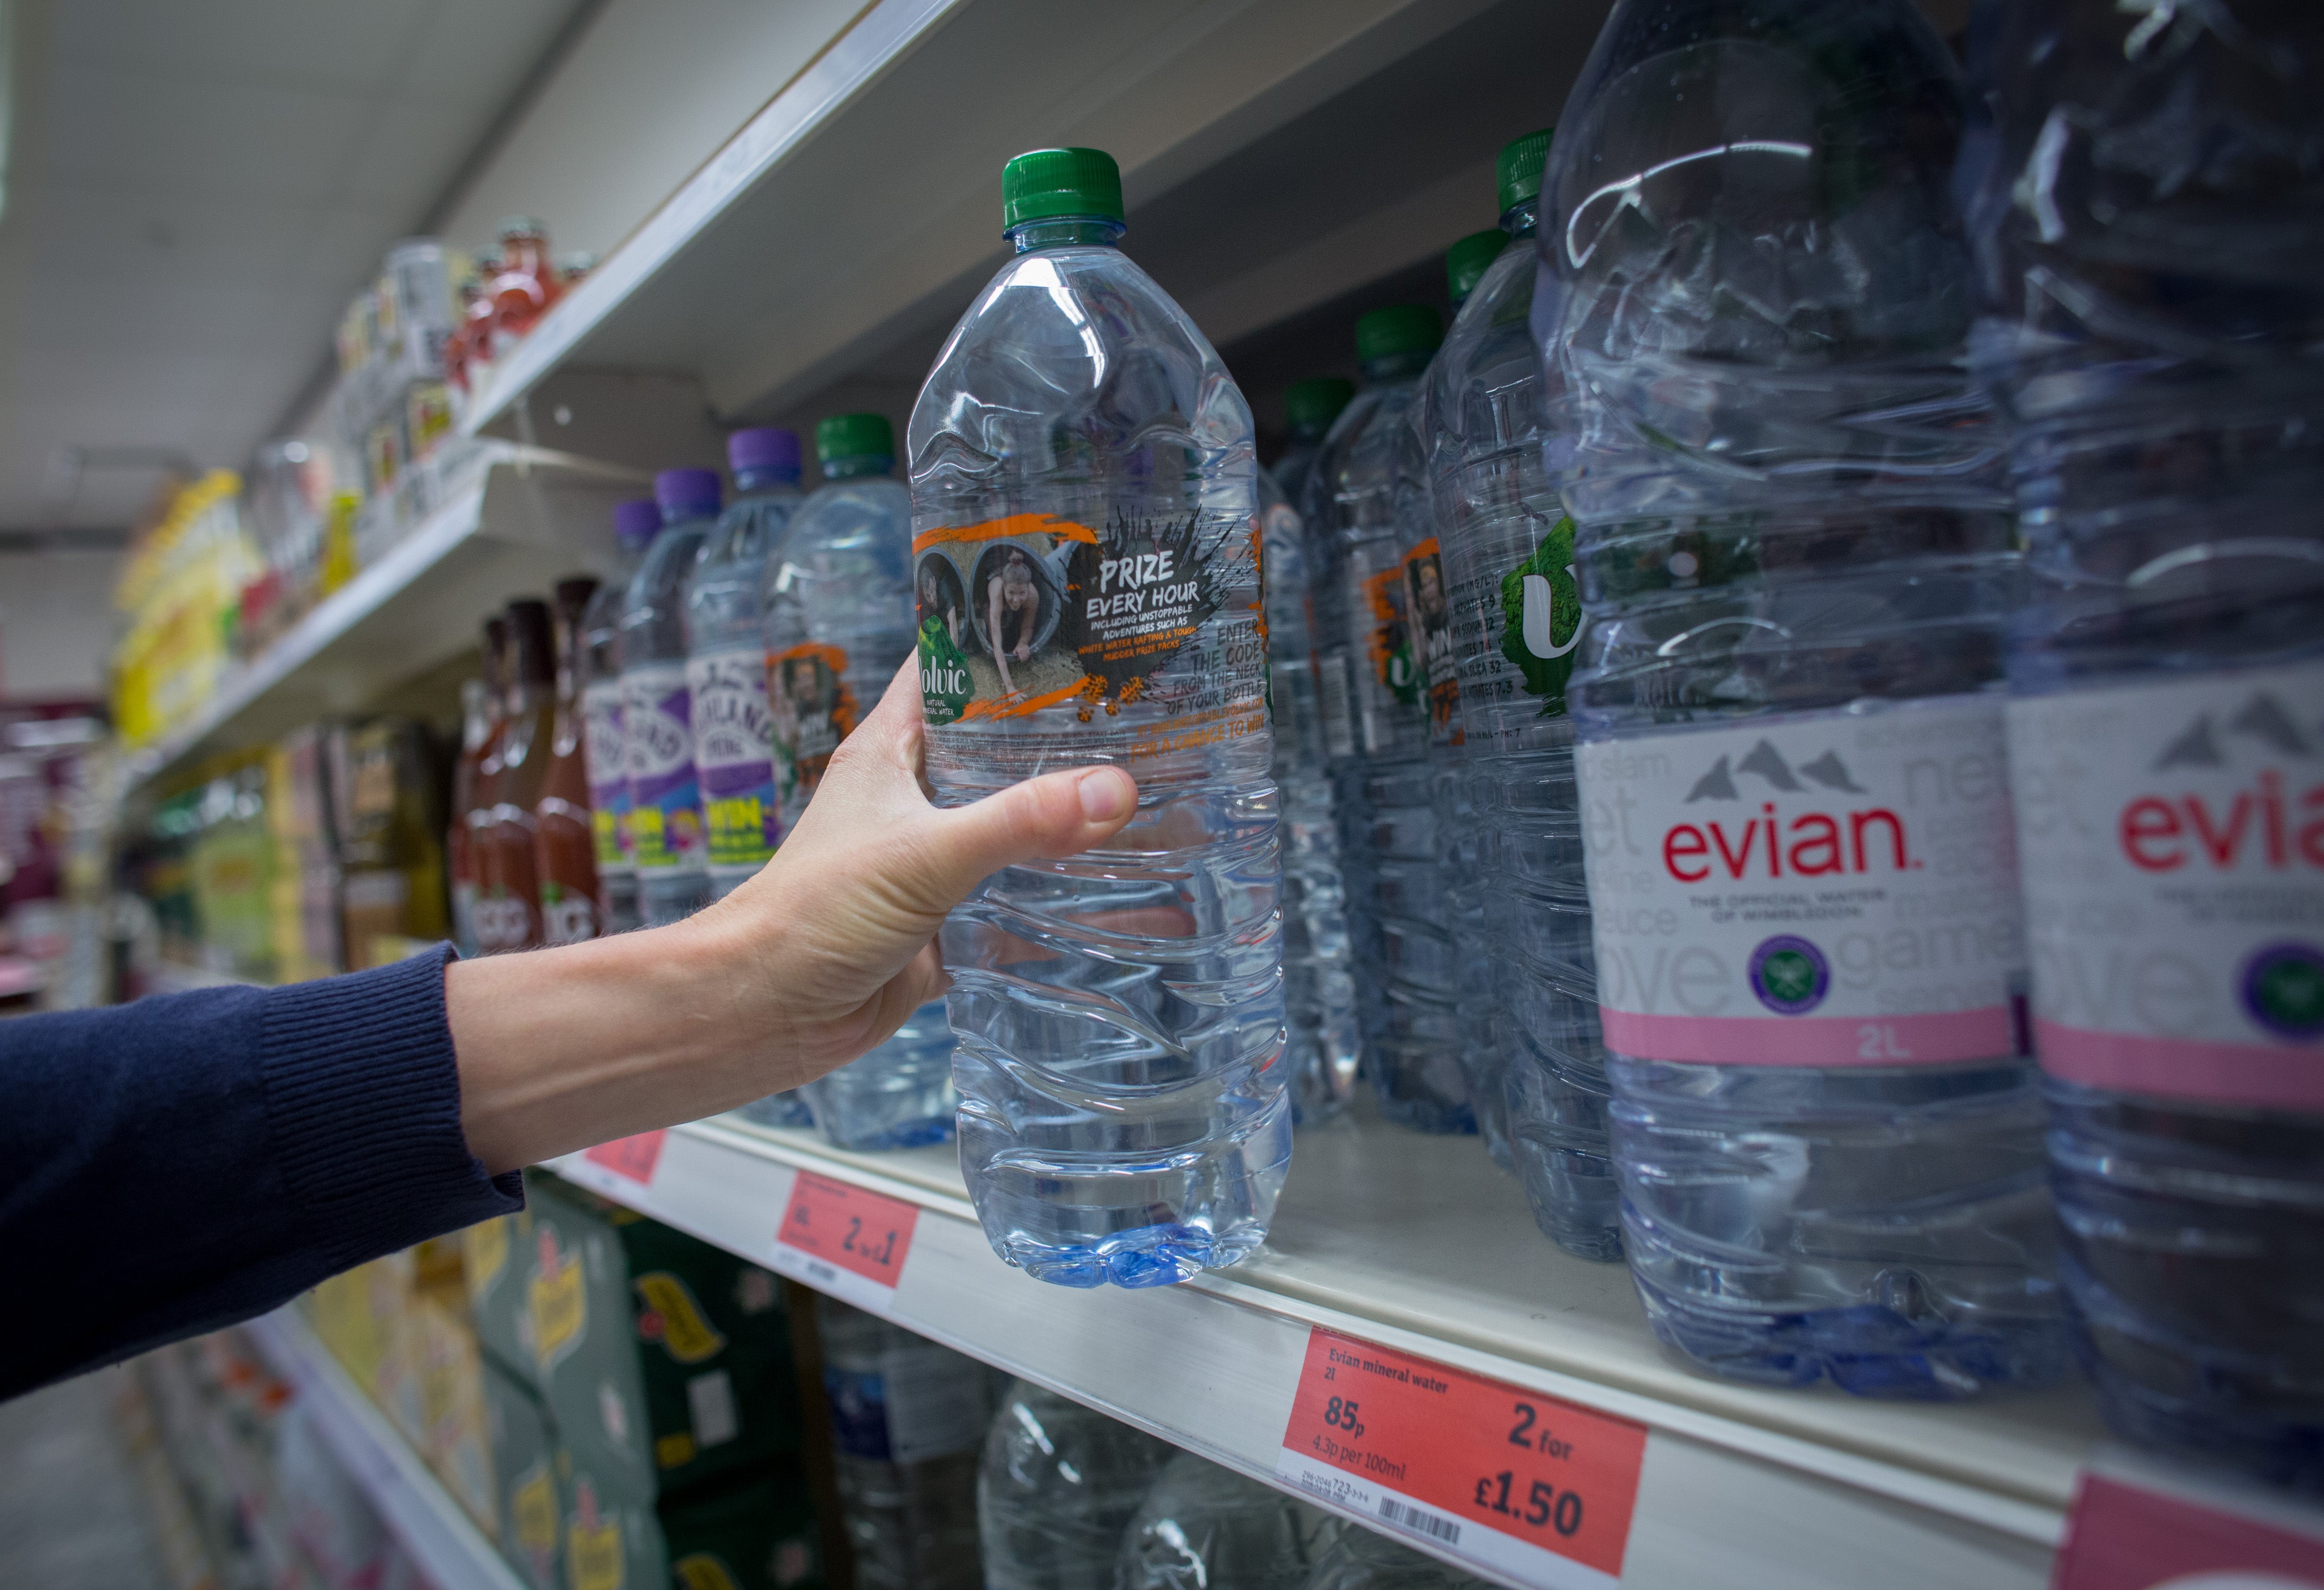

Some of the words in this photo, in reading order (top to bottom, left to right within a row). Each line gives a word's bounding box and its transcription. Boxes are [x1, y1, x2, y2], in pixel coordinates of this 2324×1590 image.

[1099, 550, 1174, 594] PRIZE
[1086, 589, 1147, 619] EVERY
[1151, 581, 1200, 607] HOUR
[1091, 612, 1137, 631] INCLUDING
[1138, 604, 1193, 623] UNSTOPPABLE
[1488, 594, 1495, 610] 9
[1078, 642, 1103, 656] WHITE
[1106, 638, 1132, 652] WATER
[1133, 632, 1164, 648] RAFTING
[1173, 625, 1198, 638] TOUGH
[1102, 620, 1155, 641] ADVENTURES
[1156, 619, 1176, 631] SUCH
[1177, 617, 1188, 628] AS
[1217, 618, 1260, 646] ENTER
[1485, 616, 1495, 631] 12
[1102, 649, 1135, 662] MUDDER
[1136, 644, 1156, 657] PRIZE
[1157, 639, 1180, 651] PACKS
[1190, 650, 1221, 676] THE
[1225, 640, 1260, 666] CODE
[1489, 660, 1502, 674] 32
[1173, 674, 1206, 696] FROM
[1211, 668, 1232, 688] THE
[1235, 661, 1261, 681] NECK
[1495, 680, 1513, 696] 7.3
[939, 708, 955, 716] WATER
[1166, 697, 1183, 715] OF
[1188, 690, 1221, 712] YOUR
[1223, 679, 1263, 703] BOTTLE
[1130, 740, 1159, 764] FOR
[1161, 737, 1171, 756] A
[1174, 724, 1225, 751] CHANCE
[1227, 719, 1244, 740] TO
[1247, 713, 1265, 734] WIN
[1515, 727, 1521, 738] 7
[1661, 801, 1908, 884] evian
[1856, 1023, 1912, 1059] 2L
[1328, 1347, 1360, 1370] Evian
[1362, 1359, 1409, 1384] mineral
[1412, 1373, 1449, 1395] water
[1324, 1395, 1366, 1438] 85p
[1507, 1402, 1536, 1448] 2
[1537, 1428, 1573, 1461] for
[1312, 1434, 1339, 1460] 4.3p
[1339, 1444, 1364, 1467] per
[1365, 1450, 1407, 1482] 100ml
[1473, 1469, 1583, 1538] £1.50
